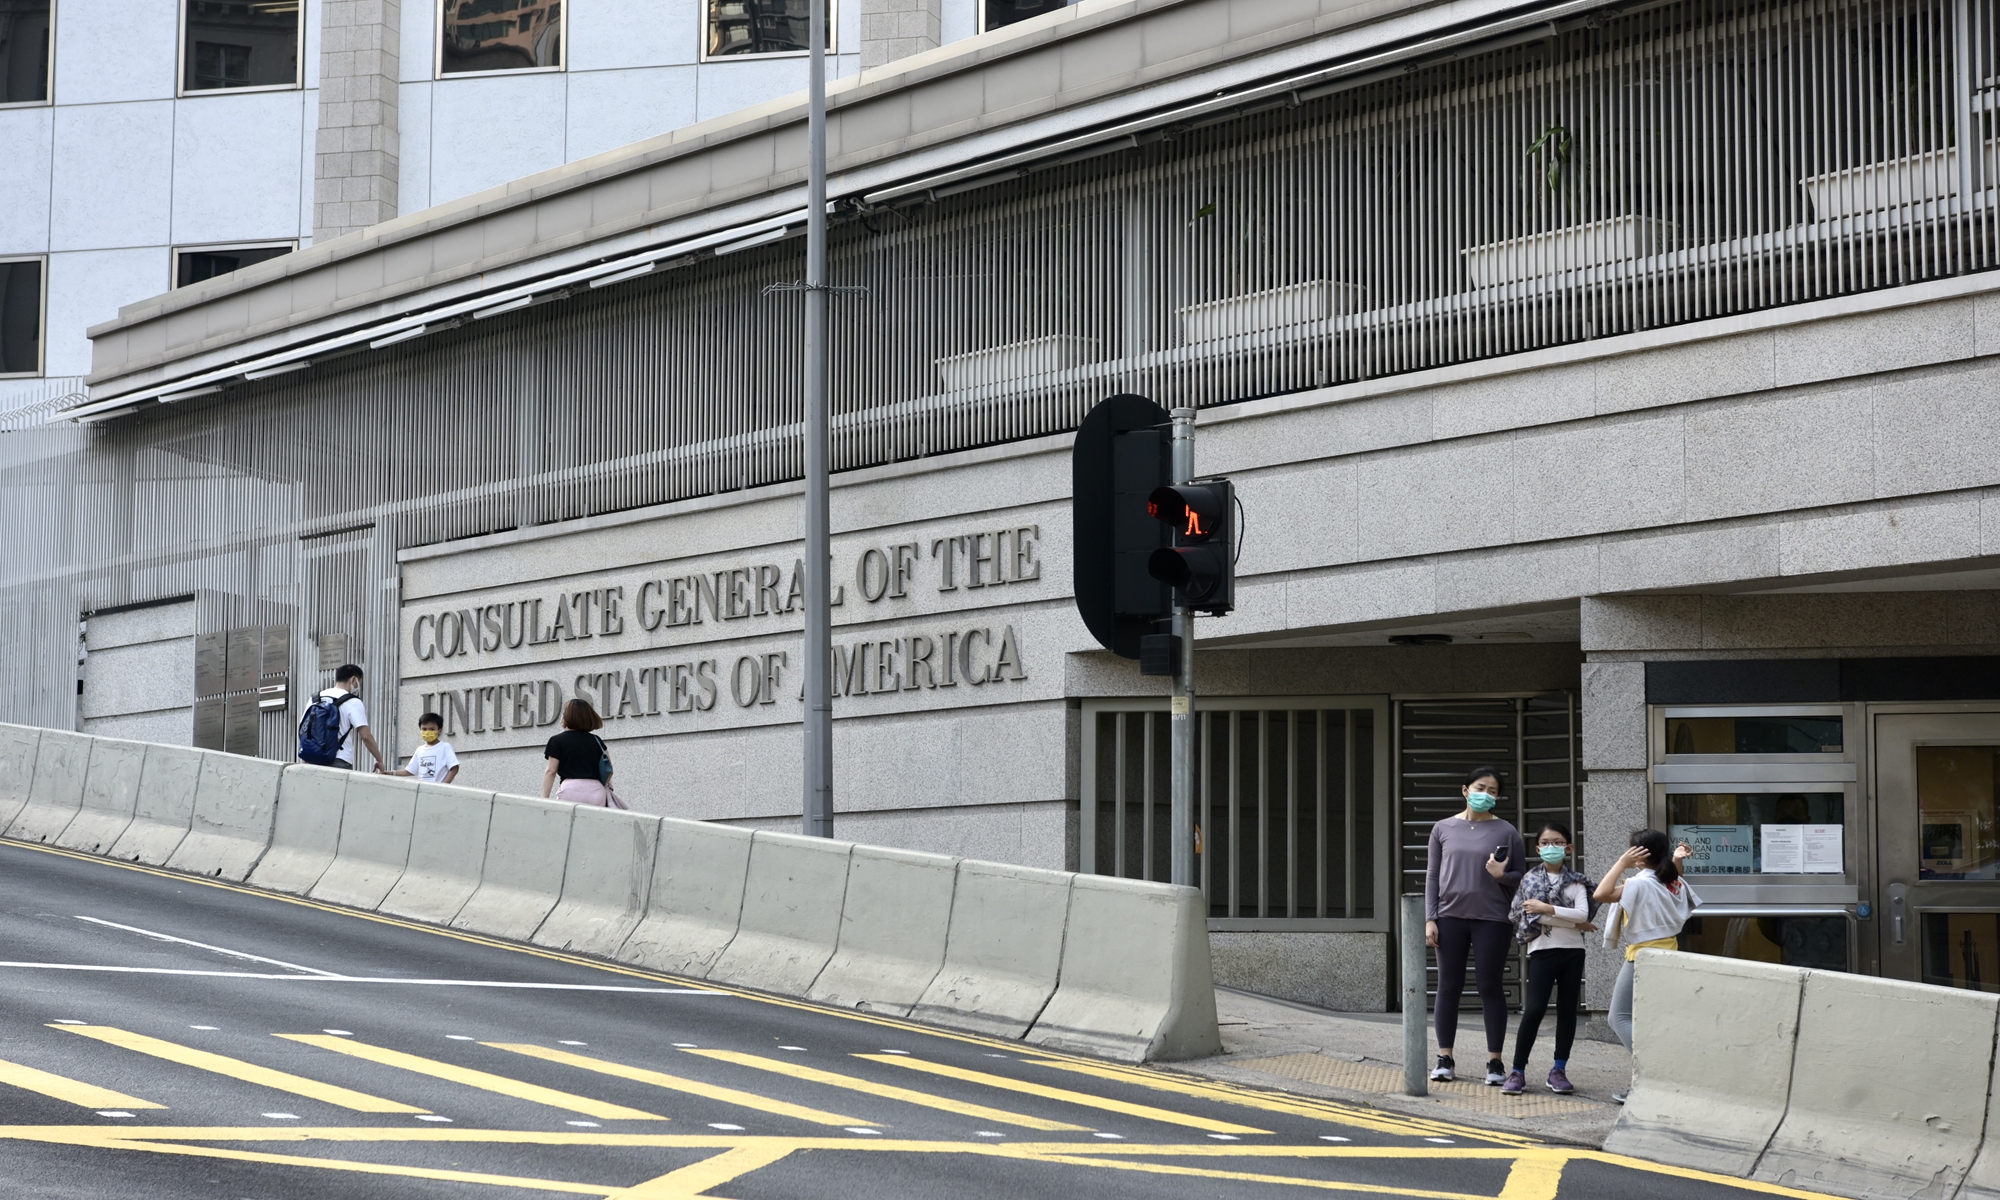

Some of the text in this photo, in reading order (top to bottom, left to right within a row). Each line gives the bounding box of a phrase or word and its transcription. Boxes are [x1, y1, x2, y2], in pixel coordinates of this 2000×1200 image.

[412, 586, 623, 660] CONSULATE
[856, 542, 918, 602] OF
[931, 525, 1040, 592] THE
[731, 651, 786, 707] OF
[799, 625, 1028, 701] MERICA
[1669, 837, 1711, 845] VISA AND
[1716, 845, 1749, 853] CITIZEN
[1683, 866, 1751, 874] 及美國公民事務部
